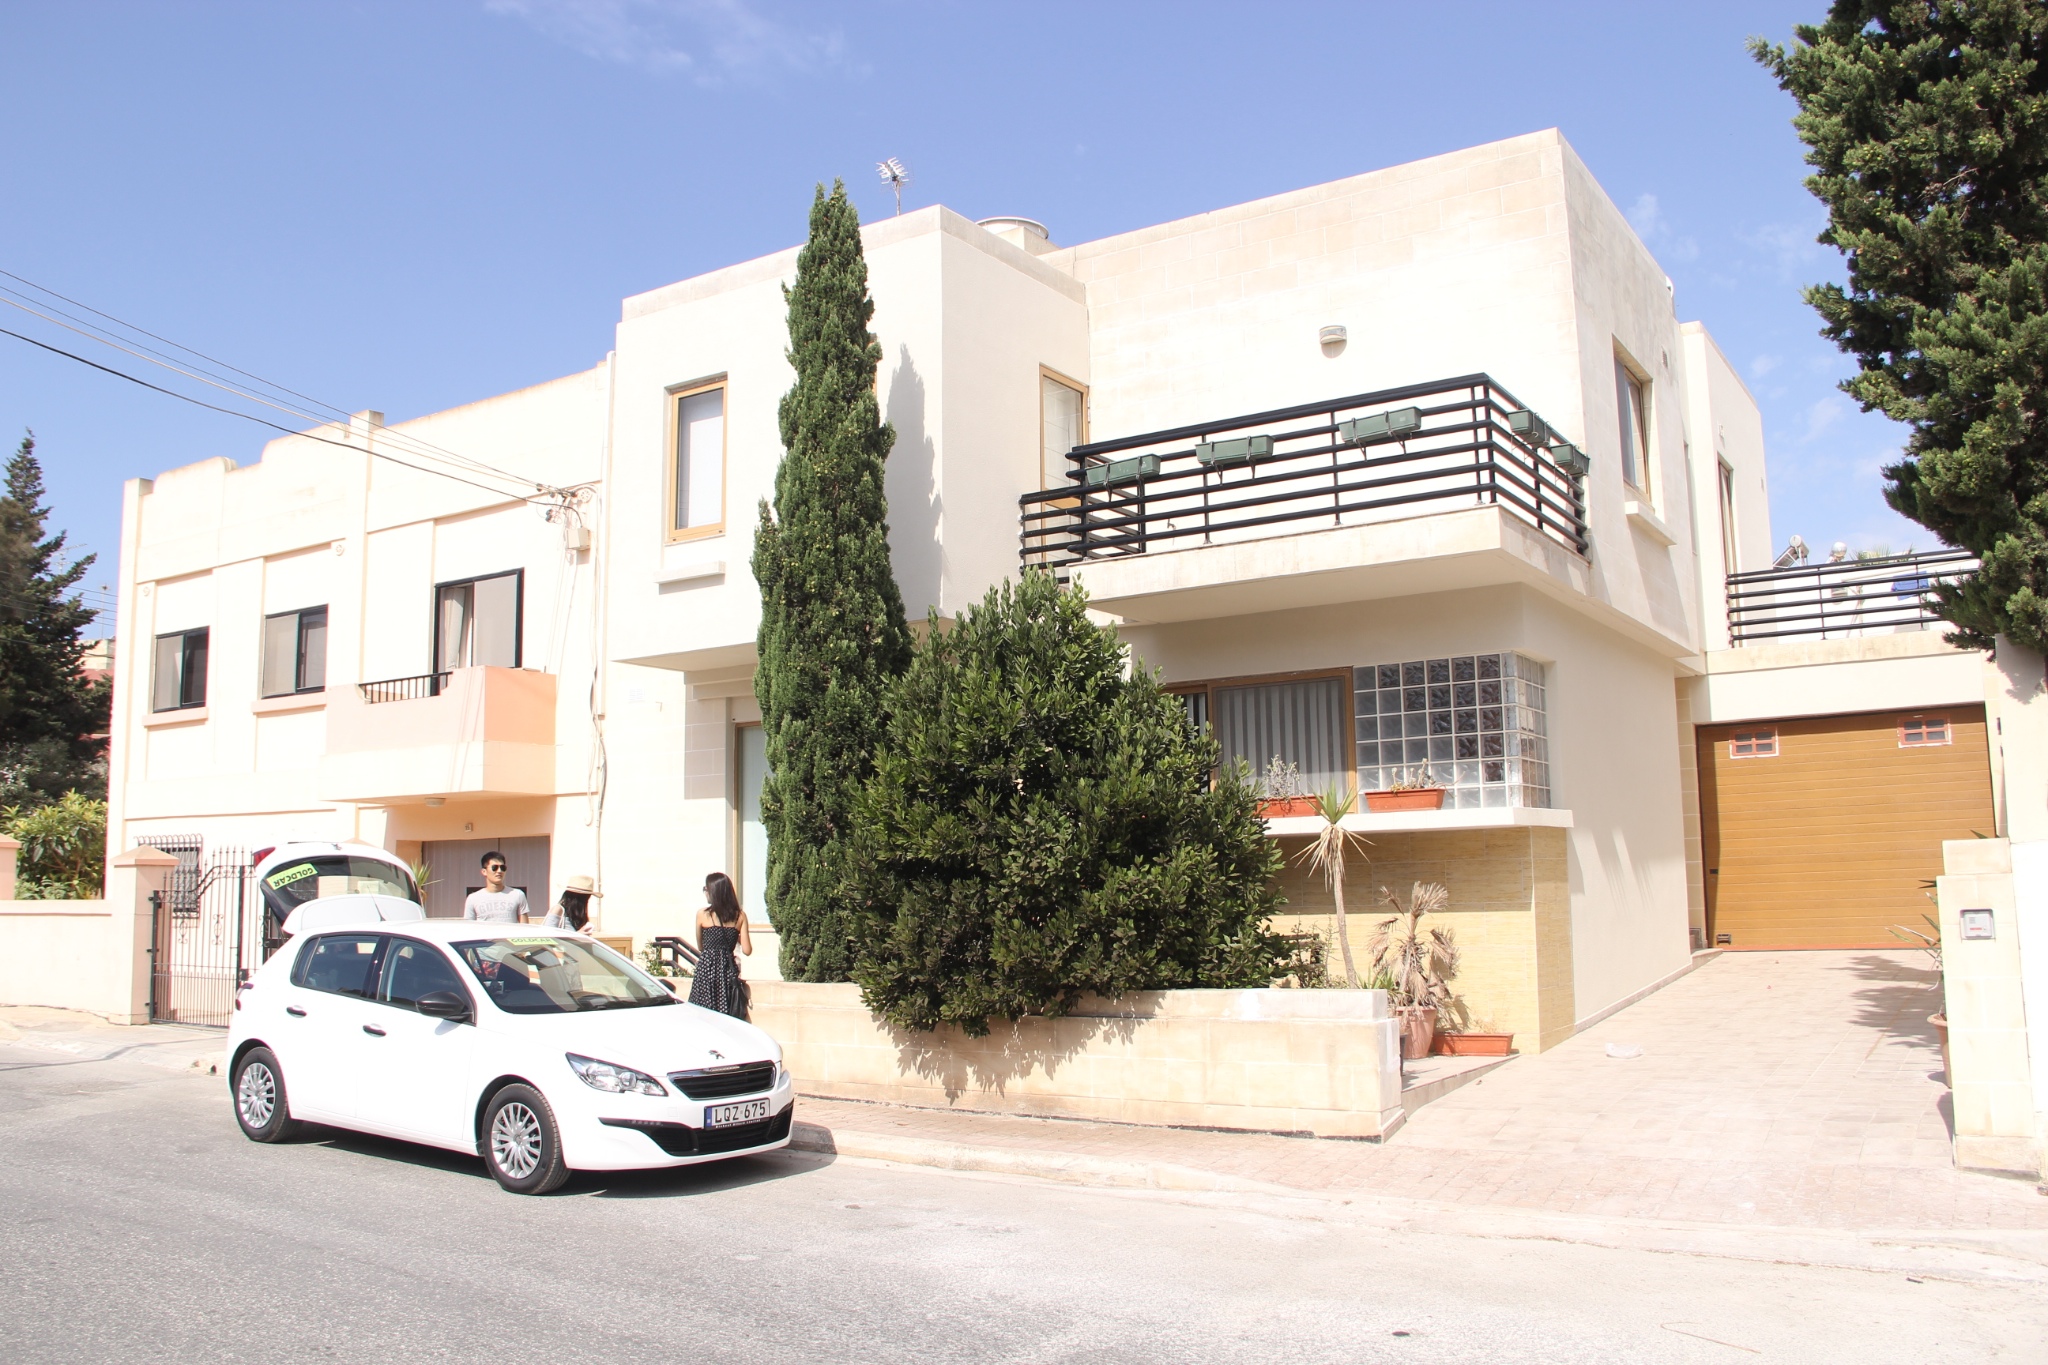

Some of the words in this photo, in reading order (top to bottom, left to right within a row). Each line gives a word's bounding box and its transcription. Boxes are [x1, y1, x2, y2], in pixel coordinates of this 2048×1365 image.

[273, 867, 314, 887] GOLDCAR
[479, 901, 515, 914] GUESS
[715, 1106, 739, 1123] LQZ
[744, 1102, 766, 1119] 675
